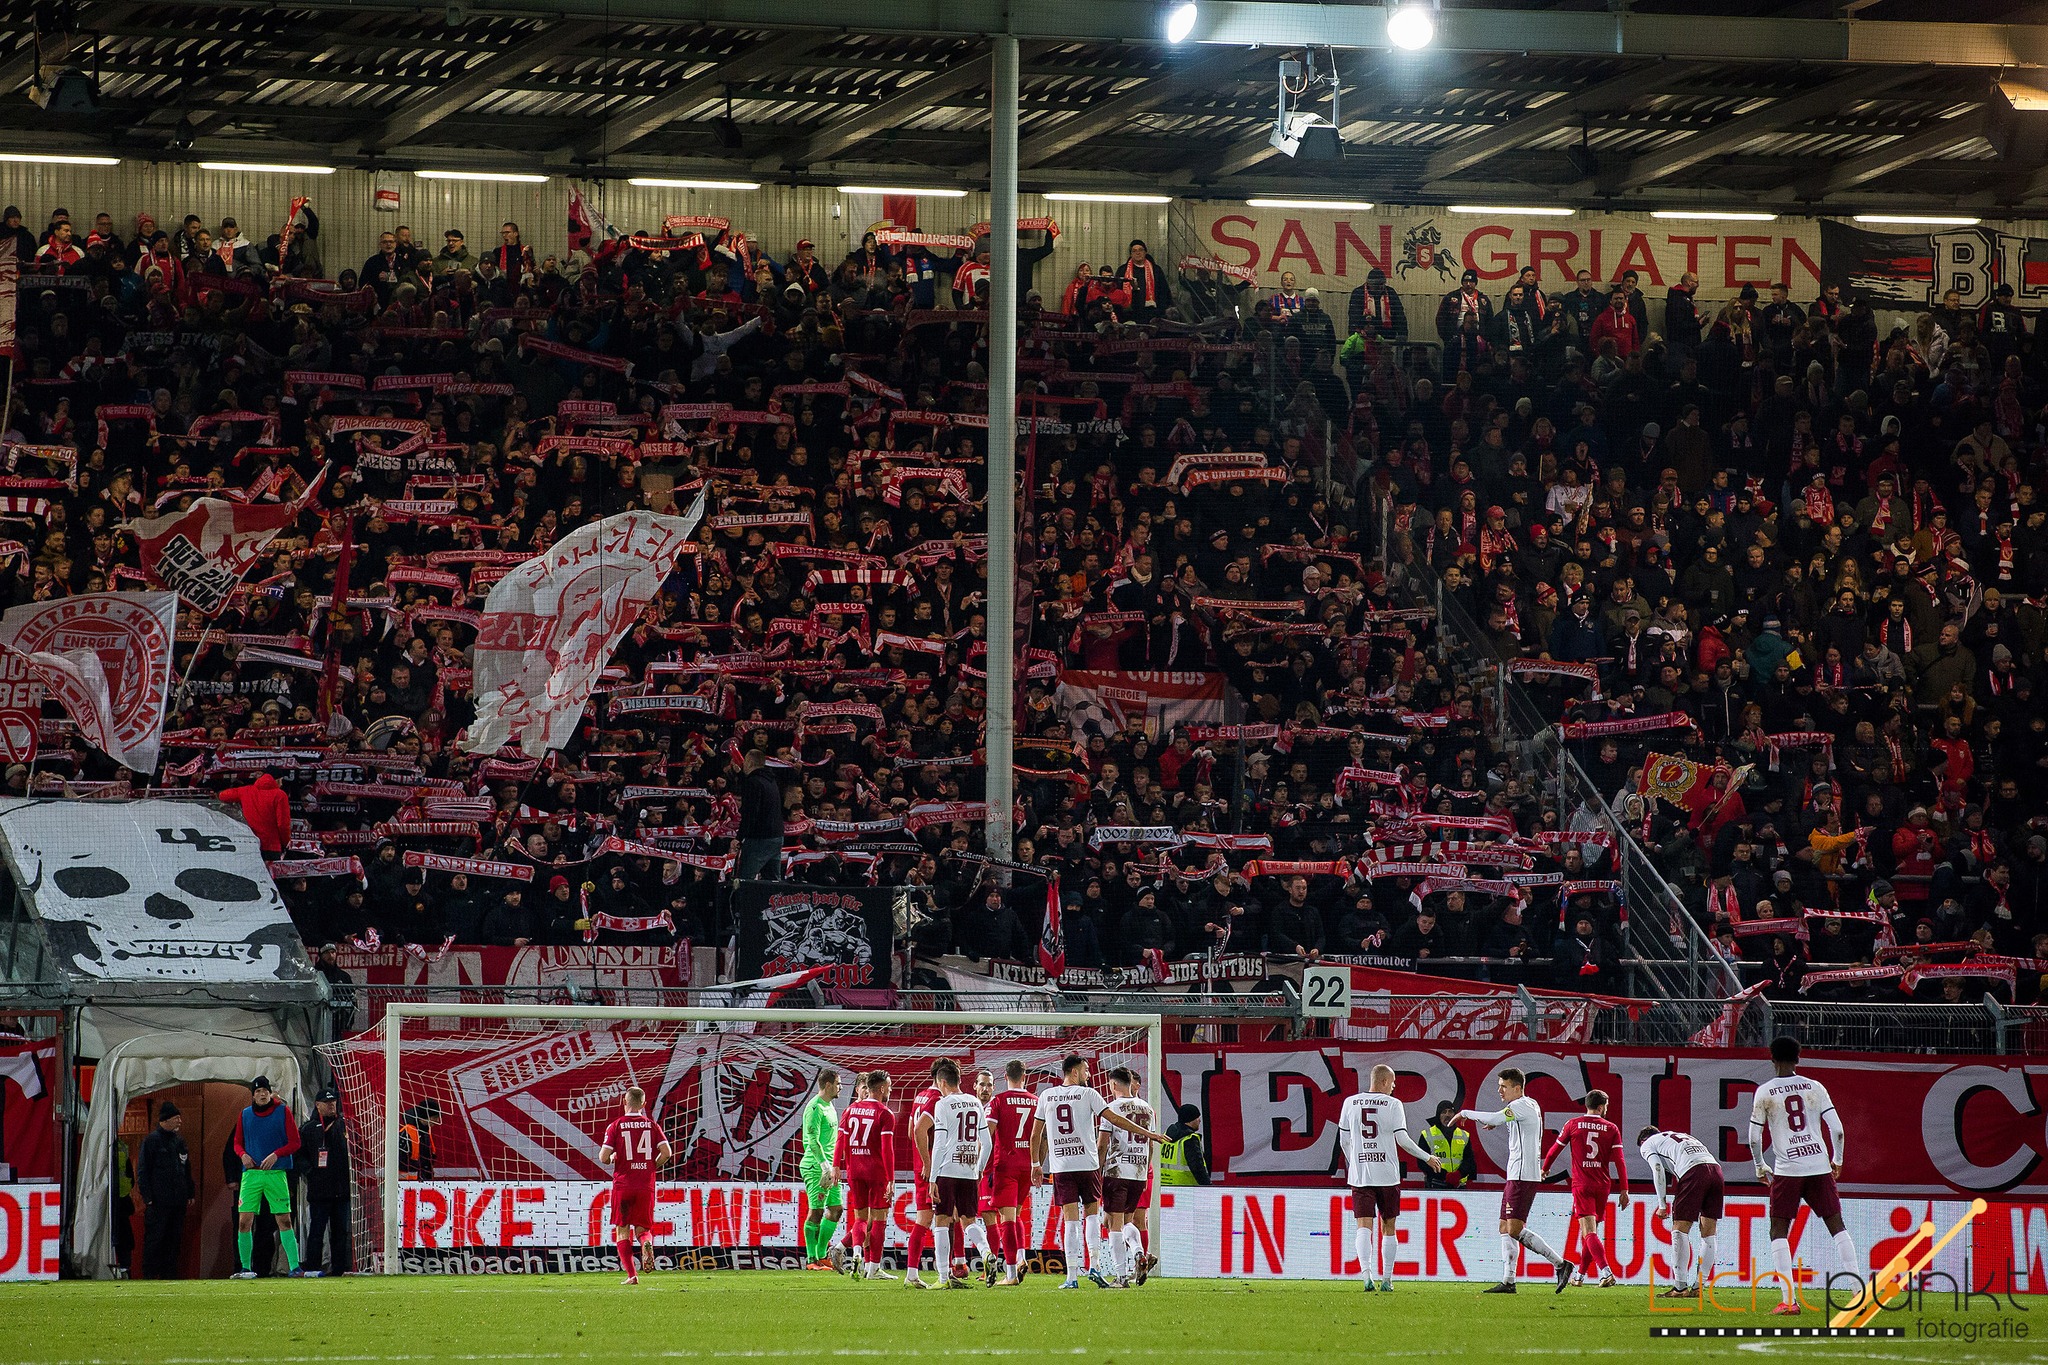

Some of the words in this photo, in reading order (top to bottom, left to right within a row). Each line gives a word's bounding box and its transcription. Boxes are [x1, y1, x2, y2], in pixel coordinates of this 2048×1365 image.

[943, 235, 973, 248] 1966
[1210, 214, 1393, 280] SAN
[1461, 224, 1822, 290] GRIATEN
[337, 417, 381, 430] ENERGIE
[717, 512, 762, 526] ENERGIE
[780, 544, 825, 559] ENERGIE
[63, 634, 119, 649] ENERGIE
[21, 600, 110, 646] ULTRAS
[125, 608, 167, 733] HOOLIGANS
[1104, 687, 1141, 701] ENERGIE
[622, 696, 667, 708] ENERGIE
[668, 696, 710, 710] COTTB
[1197, 726, 1215, 738] FC
[1353, 767, 1397, 780] ENERGIE
[1438, 815, 1485, 827] ENERGIE
[423, 853, 513, 876] ENERGIE
[992, 963, 1047, 984] AKTIVE
[1058, 967, 1104, 986] UGEND
[1201, 957, 1264, 981] COTTBUS
[1307, 974, 1346, 1008] 22
[479, 1029, 598, 1096] ENERGIE
[566, 1080, 628, 1114] COTTBUS
[1058, 1093, 1082, 1101] DYNAMO
[1769, 1086, 1784, 1096] BFC
[1784, 1083, 1812, 1094] DYNAMO
[1006, 1097, 1038, 1107] ENERGIE
[1364, 1099, 1388, 1107] DYNAMO
[1056, 1103, 1075, 1135] 9
[1783, 1094, 1806, 1133] 8
[620, 1120, 652, 1130] ENERGIE
[956, 1110, 978, 1143] 18
[1015, 1107, 1032, 1139] 7
[1361, 1107, 1379, 1139] 5
[1577, 1121, 1609, 1132] ENERGIE
[848, 1117, 875, 1147] 27
[620, 1130, 653, 1162] 14
[1063, 1146, 1085, 1156] BBK
[1363, 1142, 1378, 1150] EDER
[1585, 1131, 1600, 1160] 5
[1799, 1142, 1821, 1157] BBK
[1365, 1152, 1386, 1163] BBK
[1220, 1194, 1286, 1275] IN
[399, 1249, 543, 1276] isenbach
